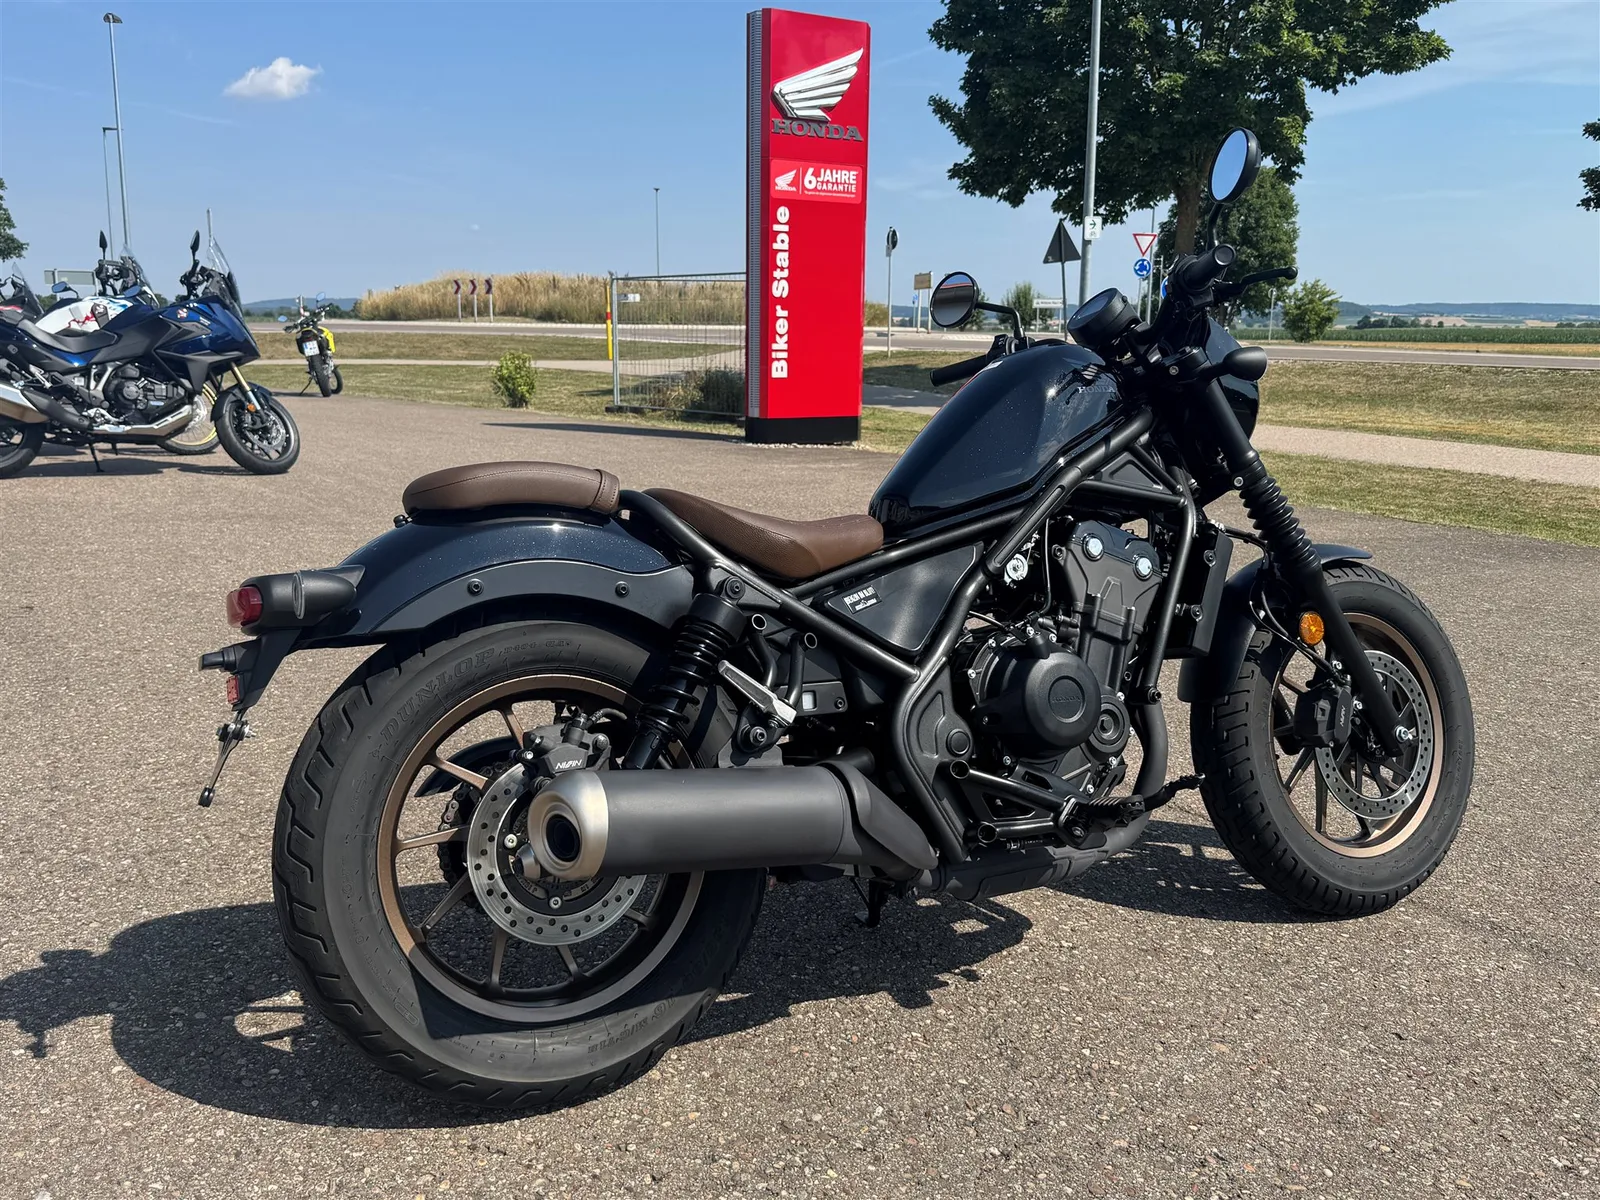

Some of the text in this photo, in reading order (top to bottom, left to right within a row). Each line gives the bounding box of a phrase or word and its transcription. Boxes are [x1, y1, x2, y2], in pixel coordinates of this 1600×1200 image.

[771, 117, 864, 141] HONDA
[803, 167, 817, 190] 6
[816, 182, 857, 193] GARANTIE
[771, 205, 790, 379] Biker Stable
[380, 647, 495, 742] DUNLOP
